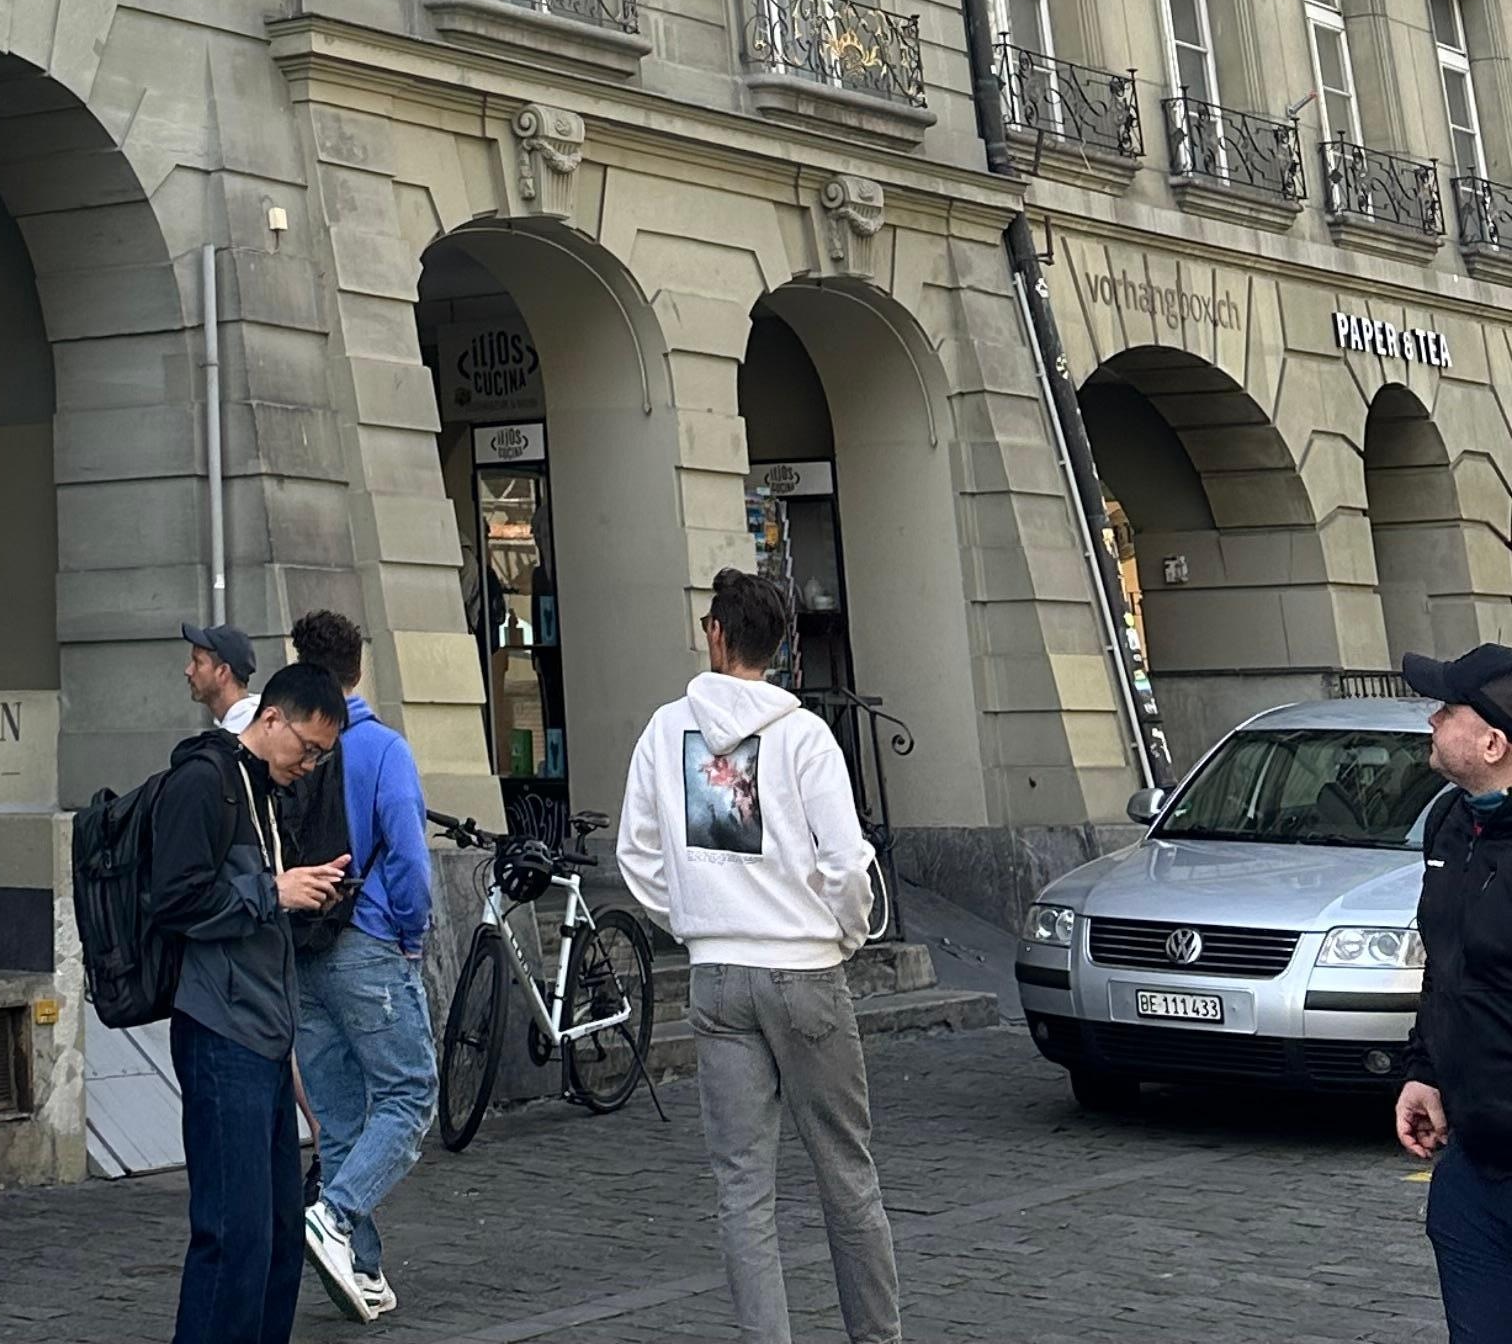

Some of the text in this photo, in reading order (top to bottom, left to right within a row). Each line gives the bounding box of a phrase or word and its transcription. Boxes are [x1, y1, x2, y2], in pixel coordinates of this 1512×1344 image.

[1085, 269, 1242, 332] vorhangbox.ch
[1333, 312, 1400, 359] PAPER
[1412, 327, 1453, 368] TEA
[473, 367, 527, 397] CUCINA
[1139, 994, 1158, 1013] BE
